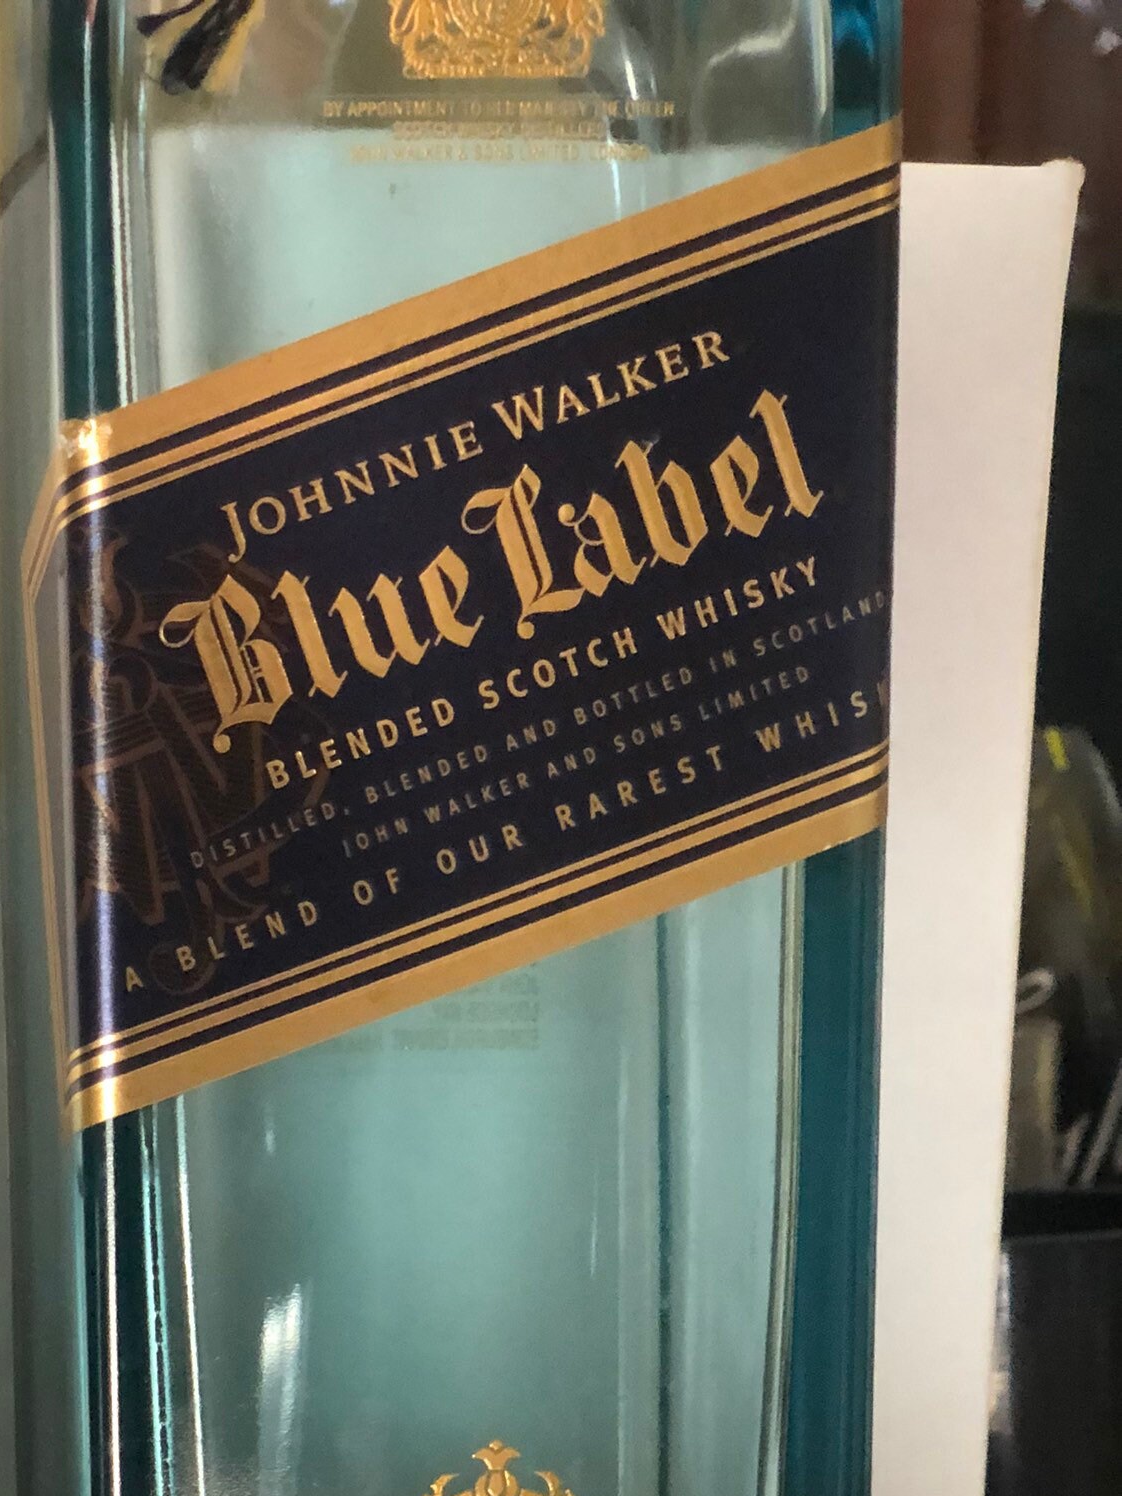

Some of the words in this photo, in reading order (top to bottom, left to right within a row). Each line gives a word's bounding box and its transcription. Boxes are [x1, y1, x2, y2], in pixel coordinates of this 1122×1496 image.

[220, 420, 483, 563] JOHNNIE
[491, 330, 731, 441] WALKER
[159, 545, 484, 753] Blue
[460, 388, 823, 640] Label
[266, 697, 455, 789] BLENDED
[477, 627, 638, 711] SCOTCH
[656, 556, 817, 641] WHISKY
[364, 744, 489, 804] BLENDED
[505, 718, 557, 752] AND
[573, 666, 693, 726] BOTTLED
[709, 649, 738, 673] IN
[424, 771, 530, 824] WALKER
[547, 747, 597, 779] AND
[612, 713, 682, 753] SONS
[698, 666, 810, 722] LIMITED
[124, 965, 144, 993] A
[175, 900, 318, 973] BLEND
[353, 867, 401, 906] OF
[436, 824, 524, 875] OUR
[555, 745, 725, 832] RAREST
